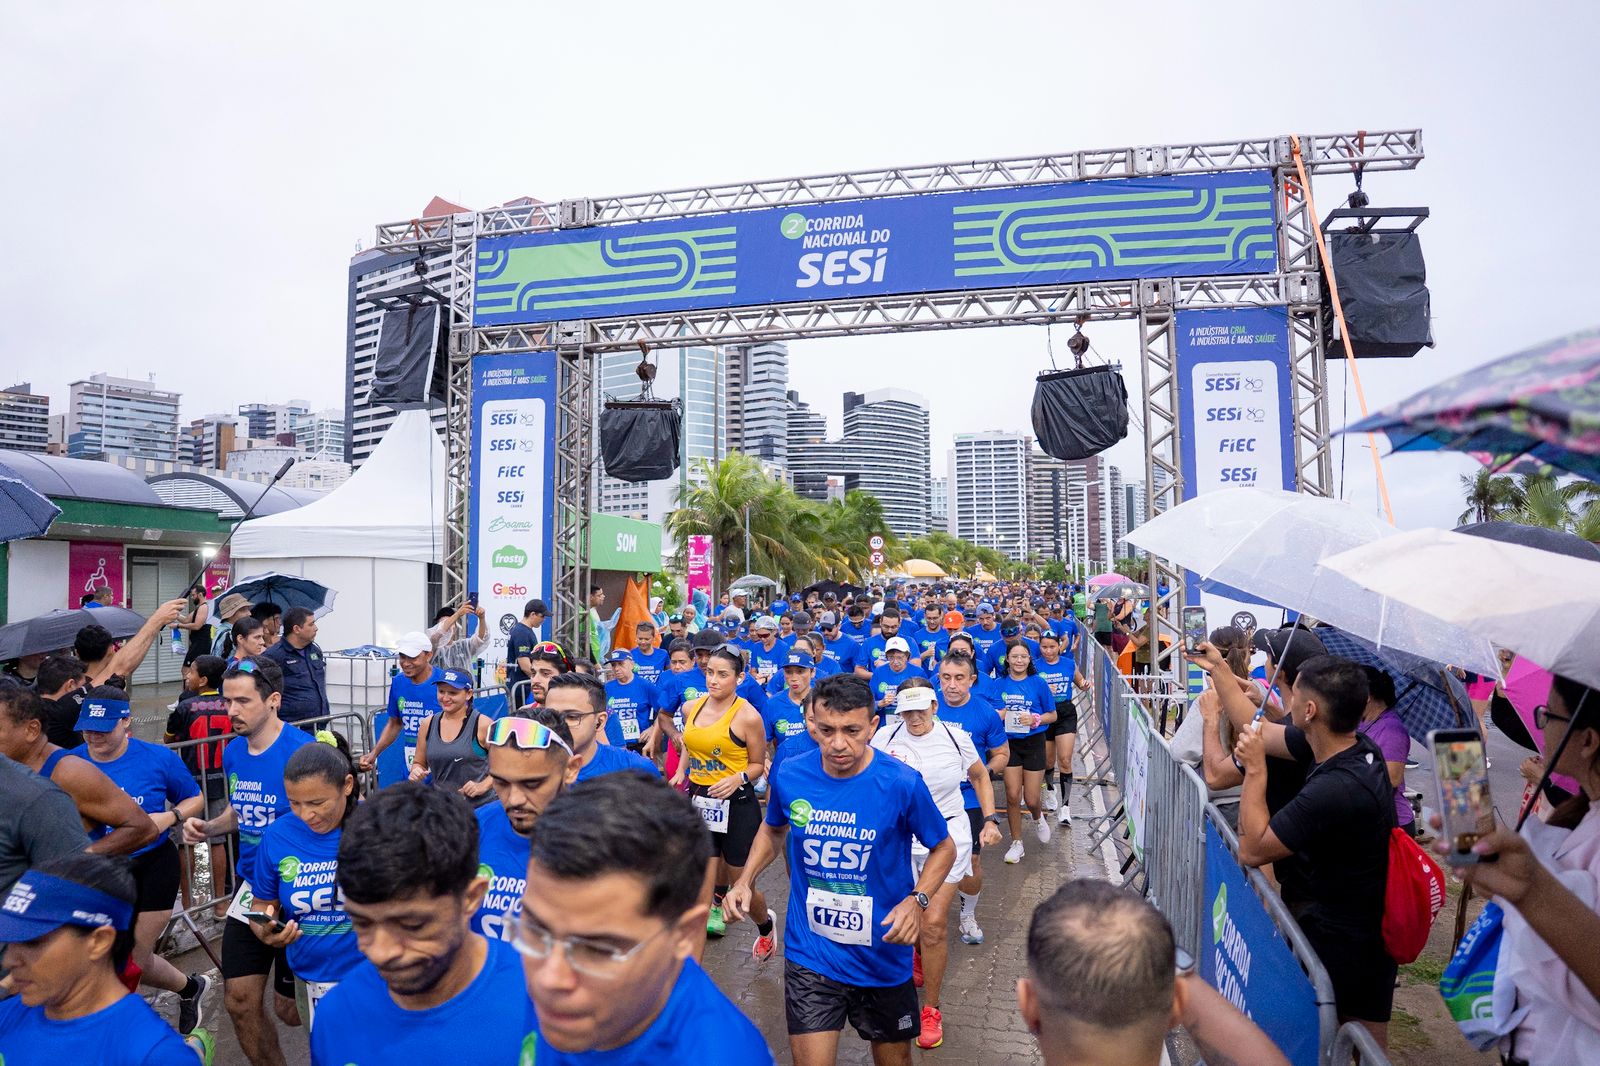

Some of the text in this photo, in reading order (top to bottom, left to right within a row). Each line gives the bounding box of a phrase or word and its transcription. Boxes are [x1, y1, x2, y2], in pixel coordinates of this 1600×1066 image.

[806, 215, 863, 232] CORRIDA
[803, 229, 891, 249] NACIONAL DO
[1196, 325, 1229, 336] INDÚSTRIA
[1197, 334, 1230, 345] INDÚSTRIA
[1237, 335, 1254, 344] MAIS
[616, 532, 637, 553] SOM
[495, 553, 525, 567] frosty
[189, 714, 232, 769] 17
[235, 778, 262, 791] CORRIDA
[231, 791, 277, 805] NACIONAL DO
[702, 808, 724, 823] 661
[808, 809, 857, 827] CORRIDA
[804, 824, 877, 841] NACIONAL DO
[296, 860, 338, 875] CORRID
[826, 871, 837, 879] PRA
[292, 871, 336, 888] NACION
[488, 875, 527, 894] CORR
[482, 893, 523, 912] NACIO
[816, 909, 862, 931] 1759
[1221, 911, 1251, 988] CORRIDA
